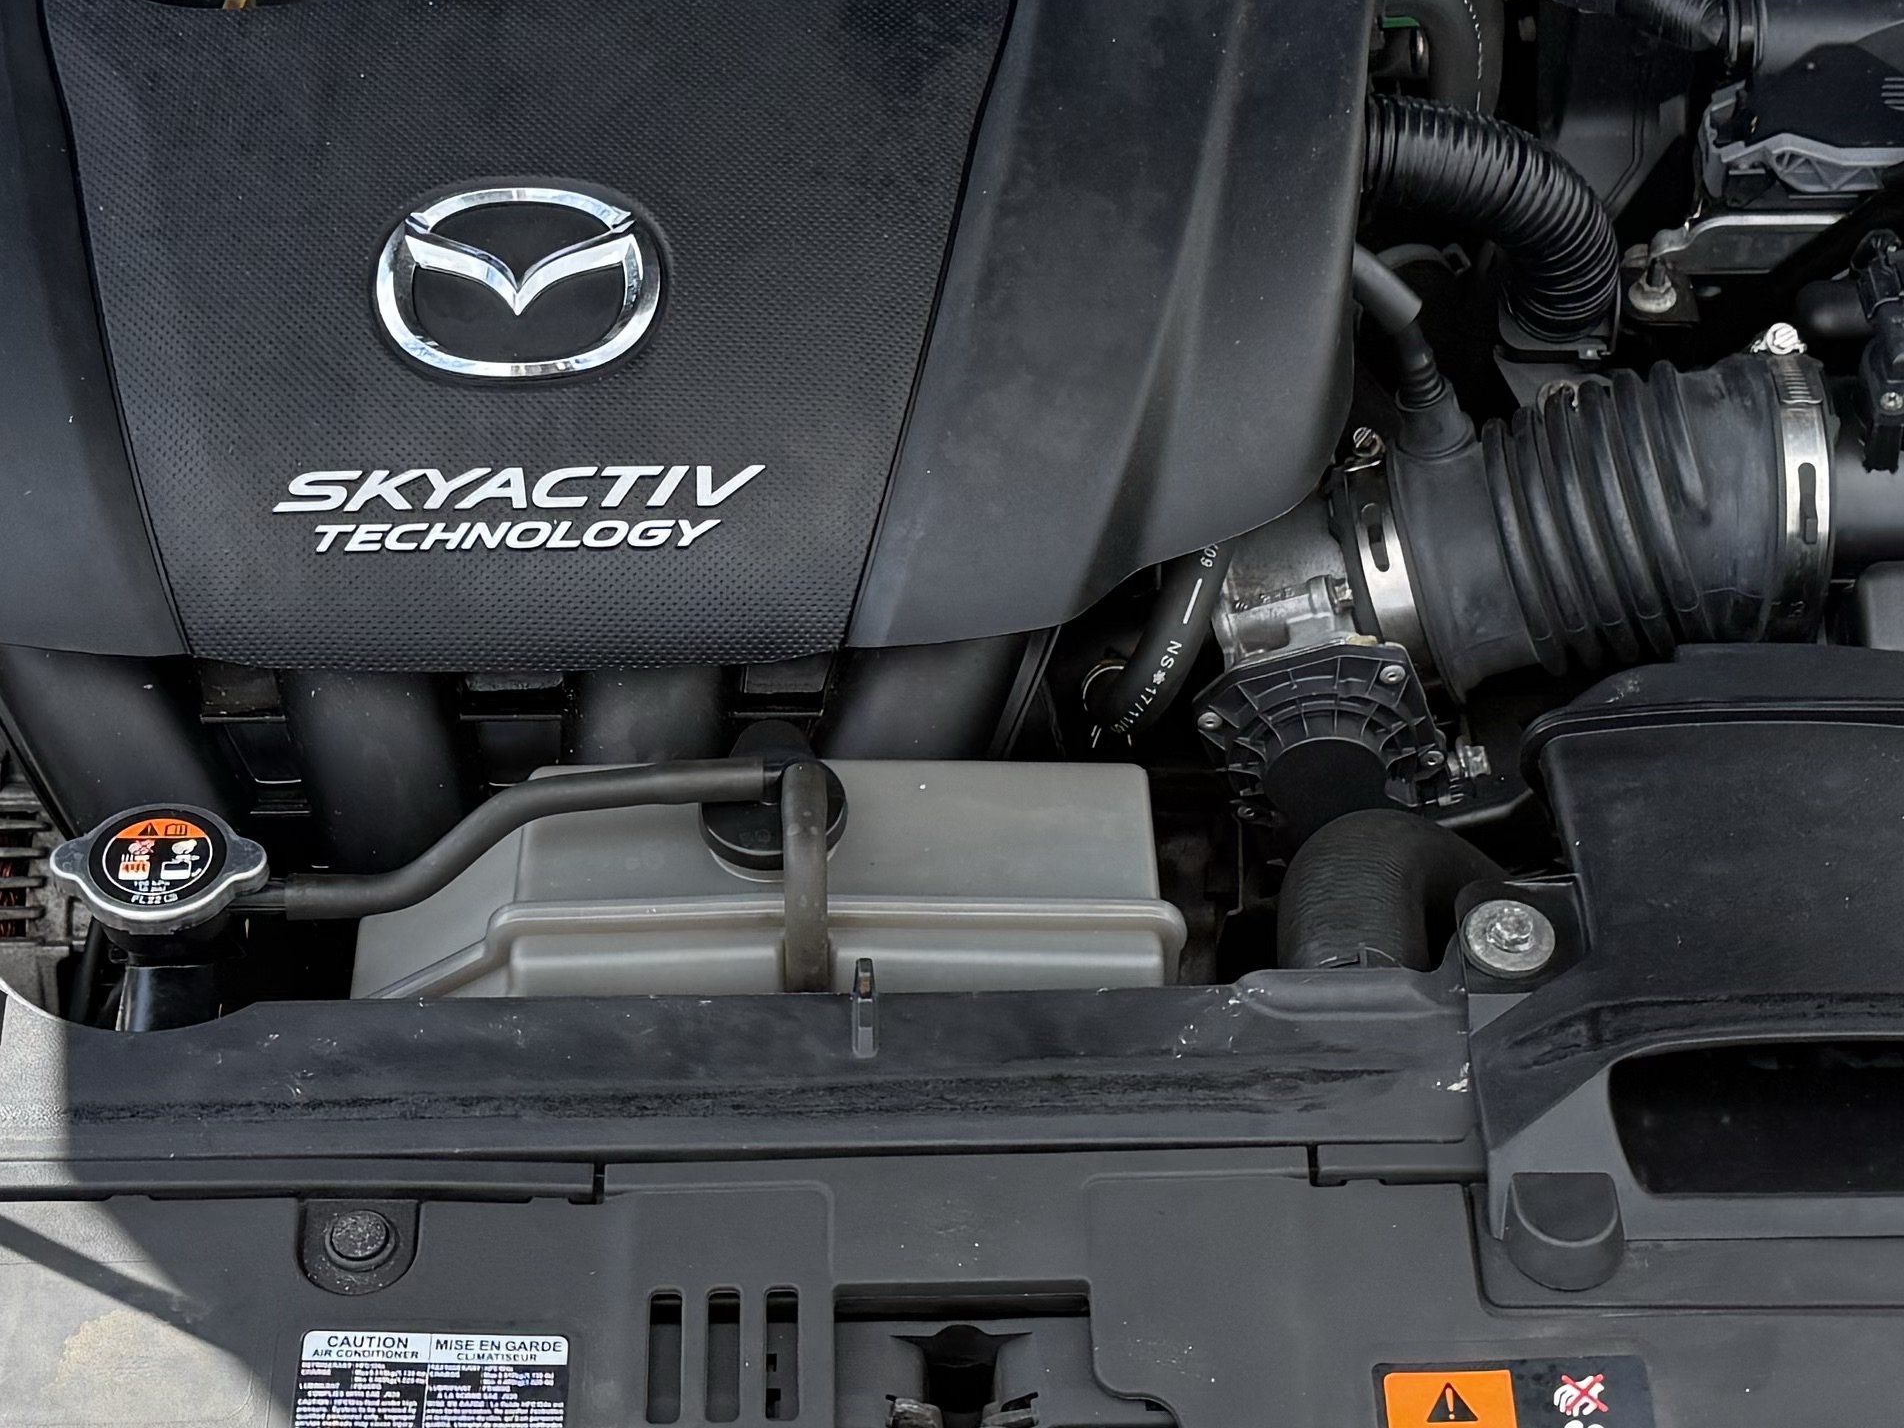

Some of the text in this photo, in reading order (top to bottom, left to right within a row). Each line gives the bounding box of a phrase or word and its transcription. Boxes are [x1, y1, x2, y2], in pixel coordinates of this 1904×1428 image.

[272, 464, 767, 513] SKYACTIV
[313, 518, 723, 554] TECHNOLOGY
[327, 1335, 409, 1349] CAUTION
[435, 1339, 563, 1353] MISE EN GARDE
[312, 1349, 419, 1359] AIR CONDITIONER
[456, 1352, 538, 1362] CLIMATISEUR
